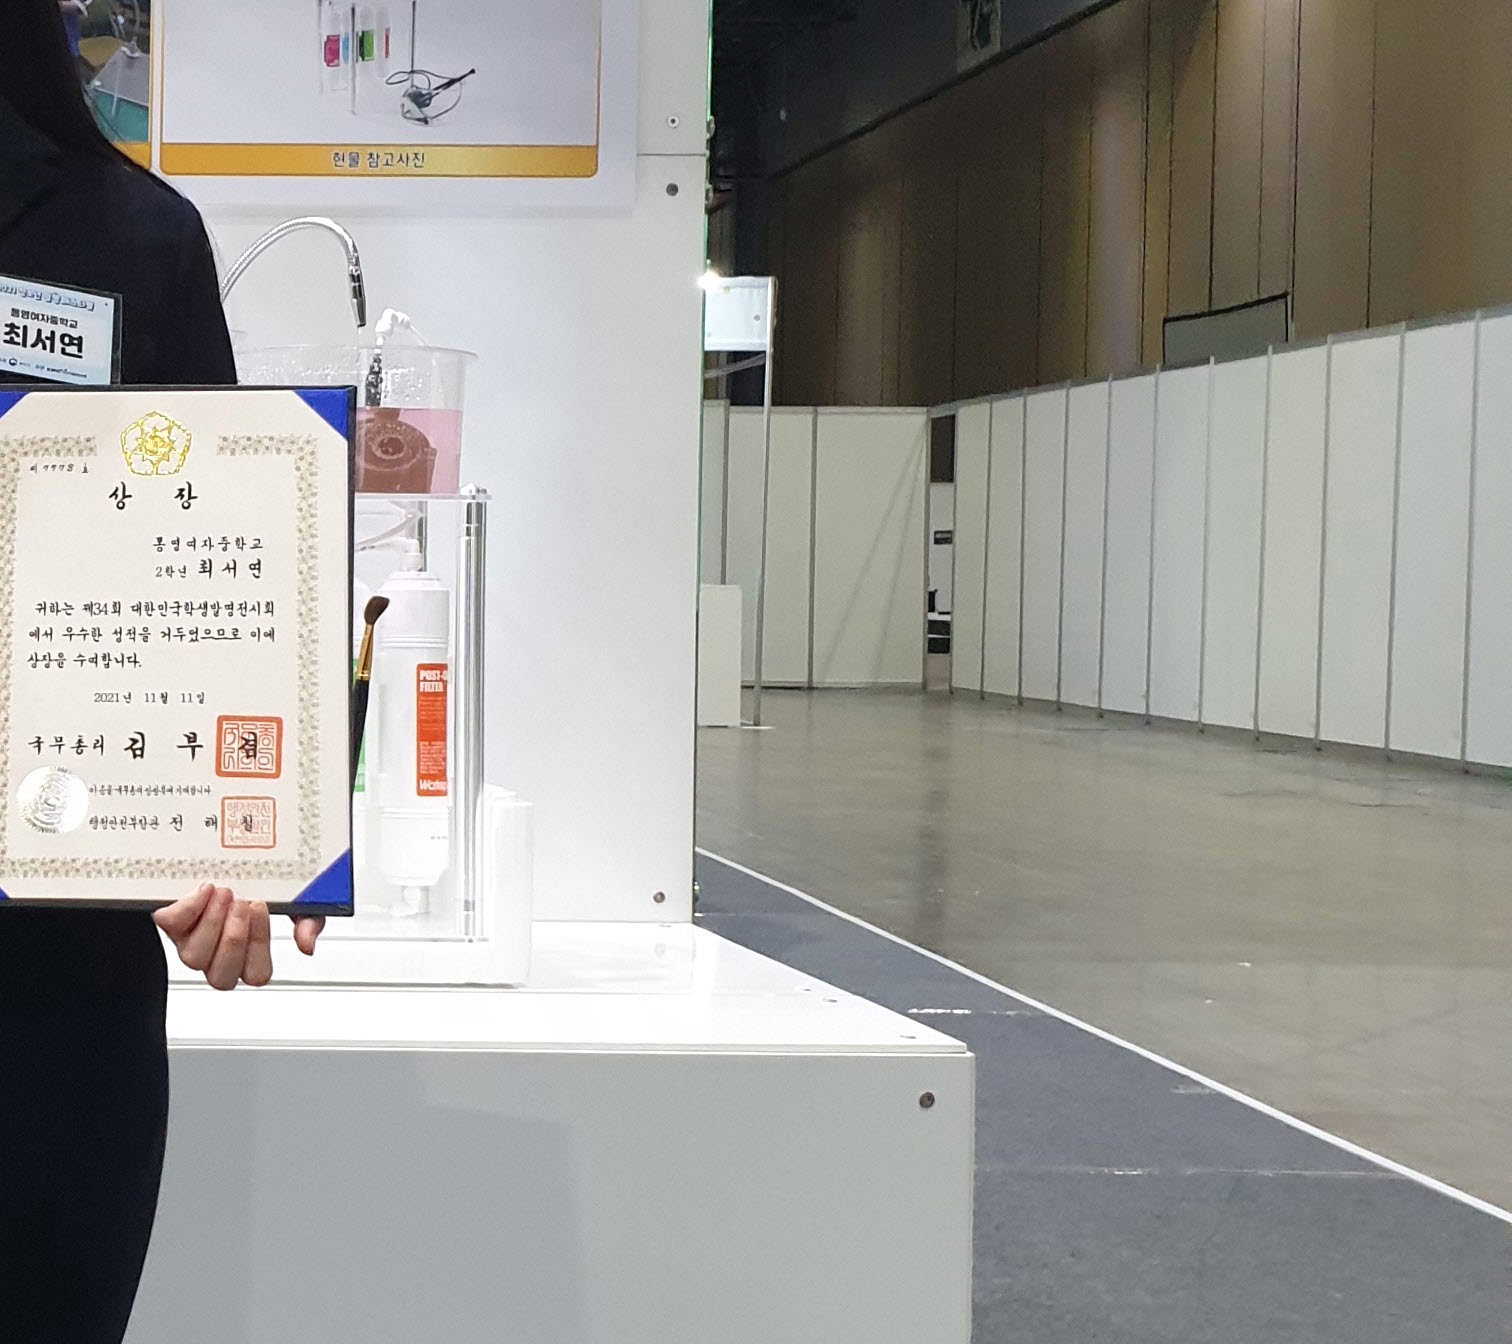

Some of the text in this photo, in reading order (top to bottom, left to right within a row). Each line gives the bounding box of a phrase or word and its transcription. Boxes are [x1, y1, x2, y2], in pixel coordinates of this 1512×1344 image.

[332, 151, 425, 170] 현물 참고사진
[11, 307, 78, 329] 통영여자중학교
[2, 322, 84, 360] 최서연
[153, 536, 263, 552] 통영여자중학교
[155, 565, 187, 579] 2학년
[35, 601, 74, 615] 귀하는
[130, 601, 273, 617] 대한민국학생발명전시회
[29, 626, 274, 643] 에서 우수한 성적을 거두었으므로 이에
[27, 651, 141, 669] 상장을 수여합니다.
[94, 691, 204, 704] 2021년 11월 11일
[28, 735, 106, 757] 국무총리
[123, 731, 147, 761] 김
[176, 731, 205, 761] 부
